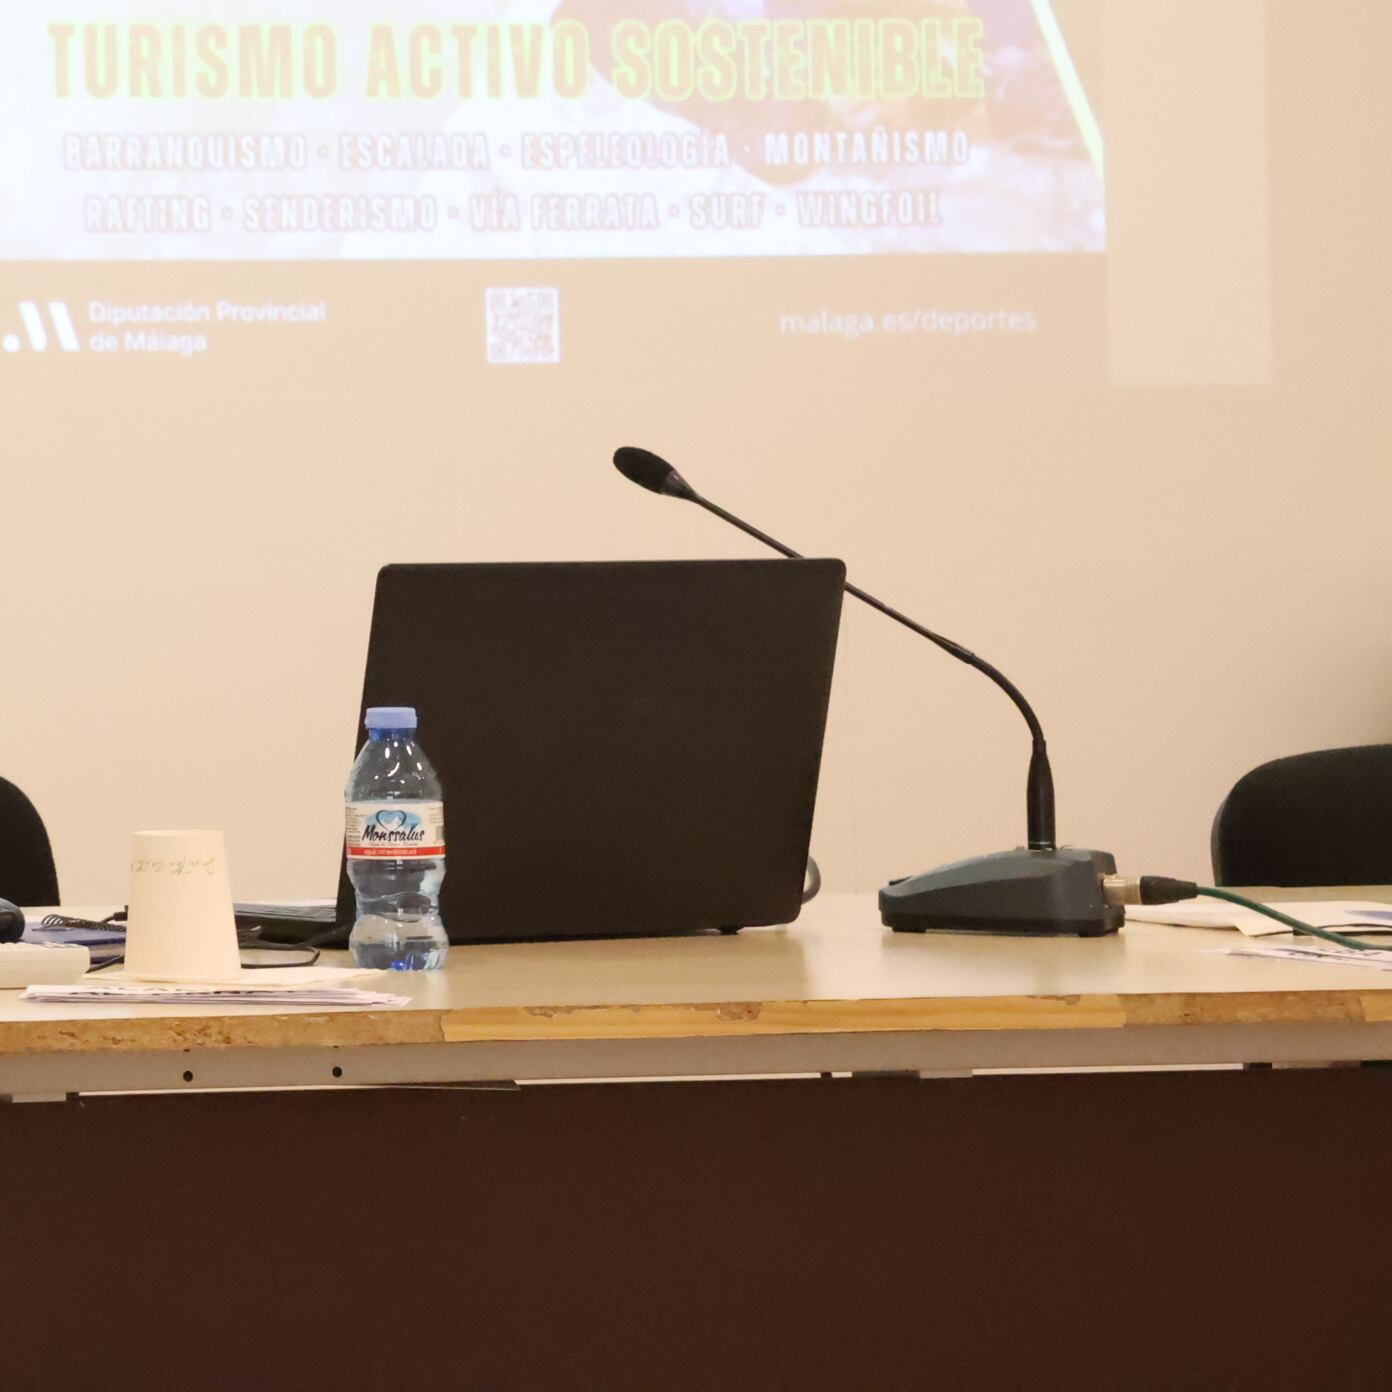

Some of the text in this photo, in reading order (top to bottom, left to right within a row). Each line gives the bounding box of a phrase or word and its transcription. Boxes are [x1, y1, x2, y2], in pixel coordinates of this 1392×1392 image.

[46, 16, 987, 102] TURISMO ACTIVO SOSTENIBLE
[63, 126, 971, 171] BARRANQUISMO ESCALADA ESPELEOLOGÍA MONTAÑISMO
[83, 187, 944, 233] RAFTING SENDERISMO VÍA FERRATA SURF WINGFOIL
[89, 299, 327, 326] Diputación Provincial
[778, 307, 1038, 338] malaga.es/deportes
[90, 330, 207, 355] de Málaga
[362, 823, 425, 842] Monssalus
